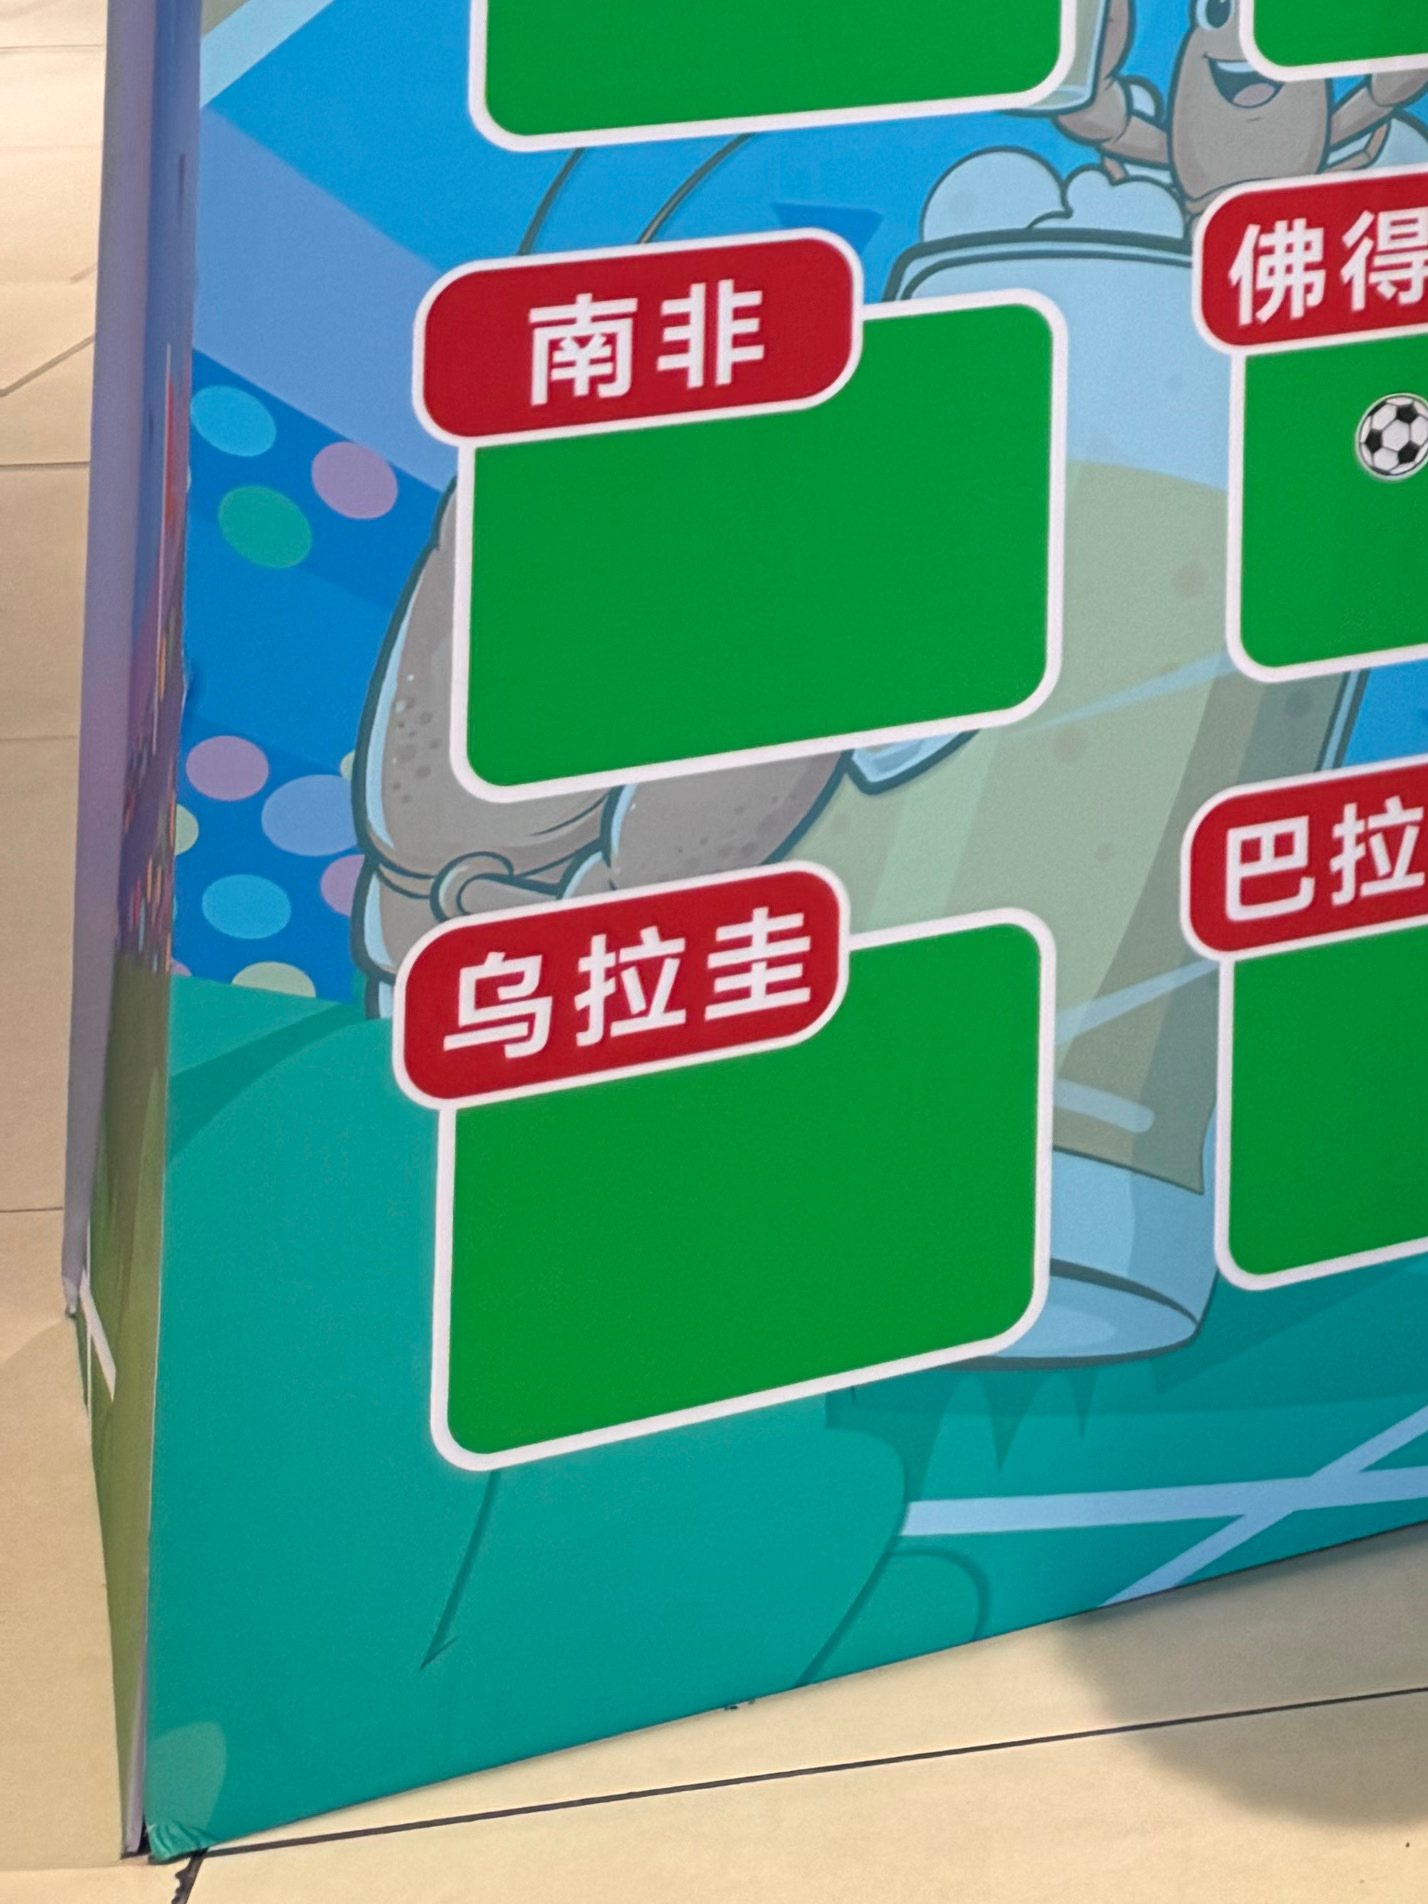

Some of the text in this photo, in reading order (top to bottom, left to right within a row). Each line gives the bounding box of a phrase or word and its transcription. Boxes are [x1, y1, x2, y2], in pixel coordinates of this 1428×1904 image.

[529, 279, 764, 405] 南非
[444, 907, 810, 1058] 乌拉圭
